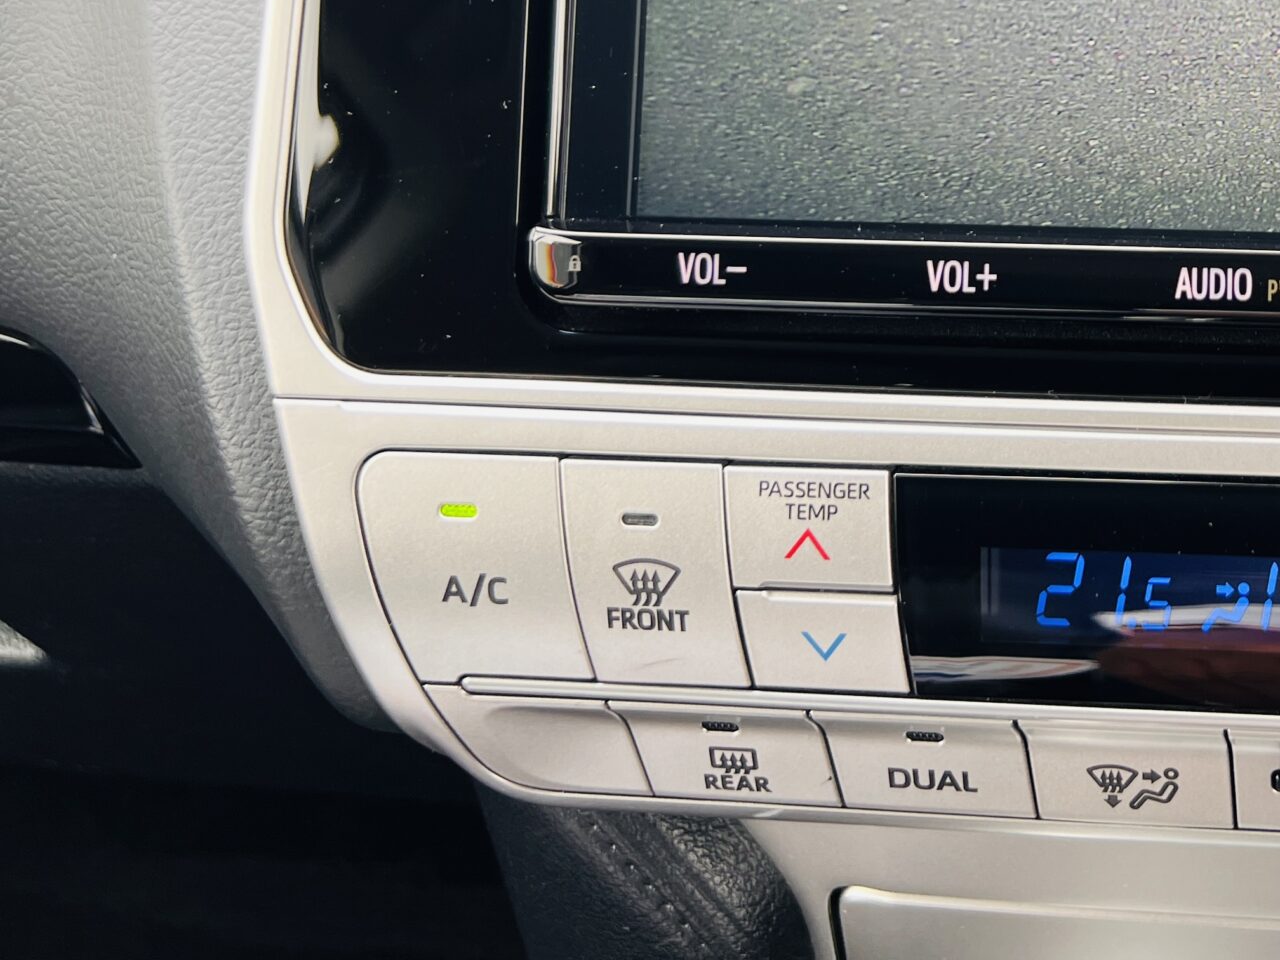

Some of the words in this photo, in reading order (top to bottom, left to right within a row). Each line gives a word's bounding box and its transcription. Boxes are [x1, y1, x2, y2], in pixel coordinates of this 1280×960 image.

[926, 259, 998, 294] VOL+
[1174, 267, 1254, 303] AUDIO
[758, 480, 871, 500] PASSENGER
[785, 503, 839, 522] TEMP
[441, 572, 510, 607] A/C
[606, 607, 690, 632] FRONT
[703, 772, 771, 794] REAR
[887, 766, 979, 794] DUAL
